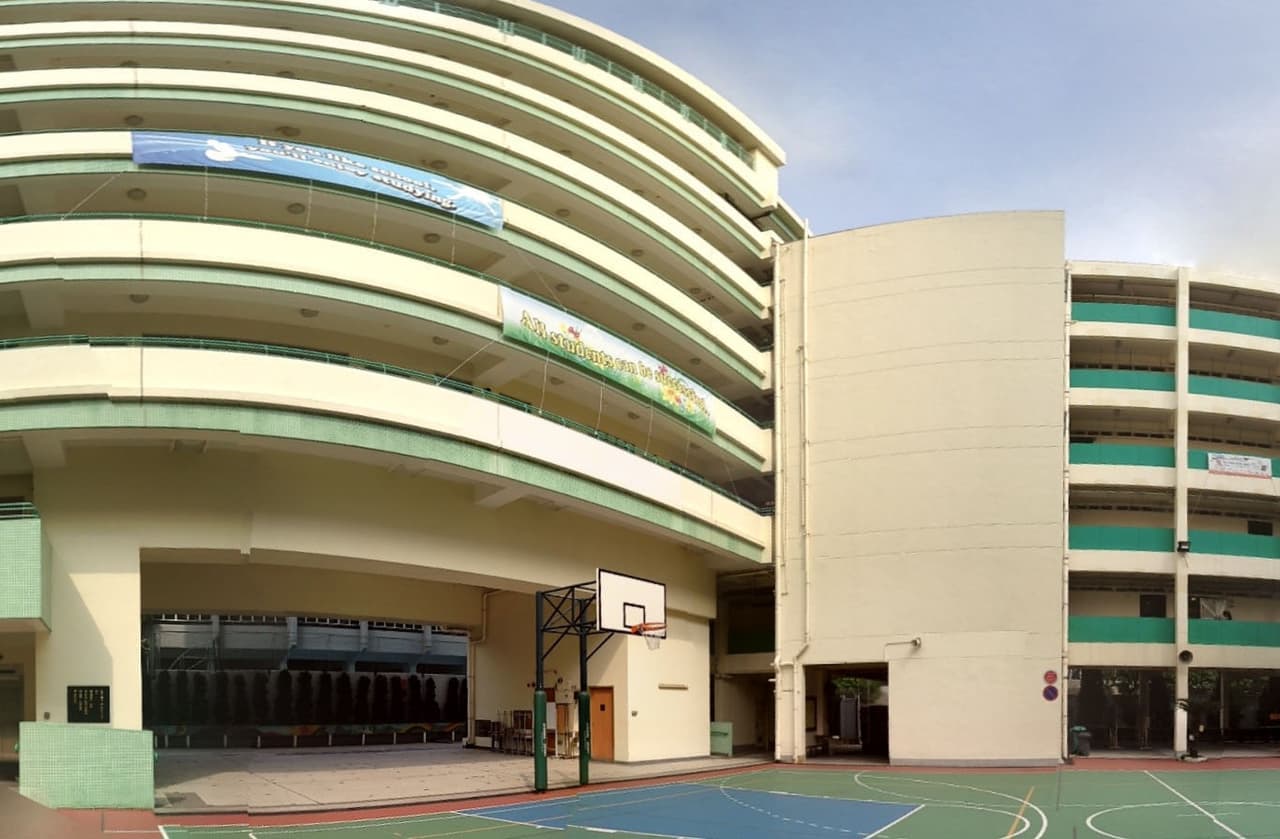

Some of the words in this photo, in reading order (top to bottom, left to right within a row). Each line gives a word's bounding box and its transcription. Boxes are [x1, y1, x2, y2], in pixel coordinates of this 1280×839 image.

[281, 143, 321, 156] you
[324, 152, 367, 169] like
[311, 158, 368, 177] enjoy
[520, 309, 548, 340] All
[550, 330, 614, 370] students
[613, 357, 639, 377] can
[638, 359, 653, 380] be
